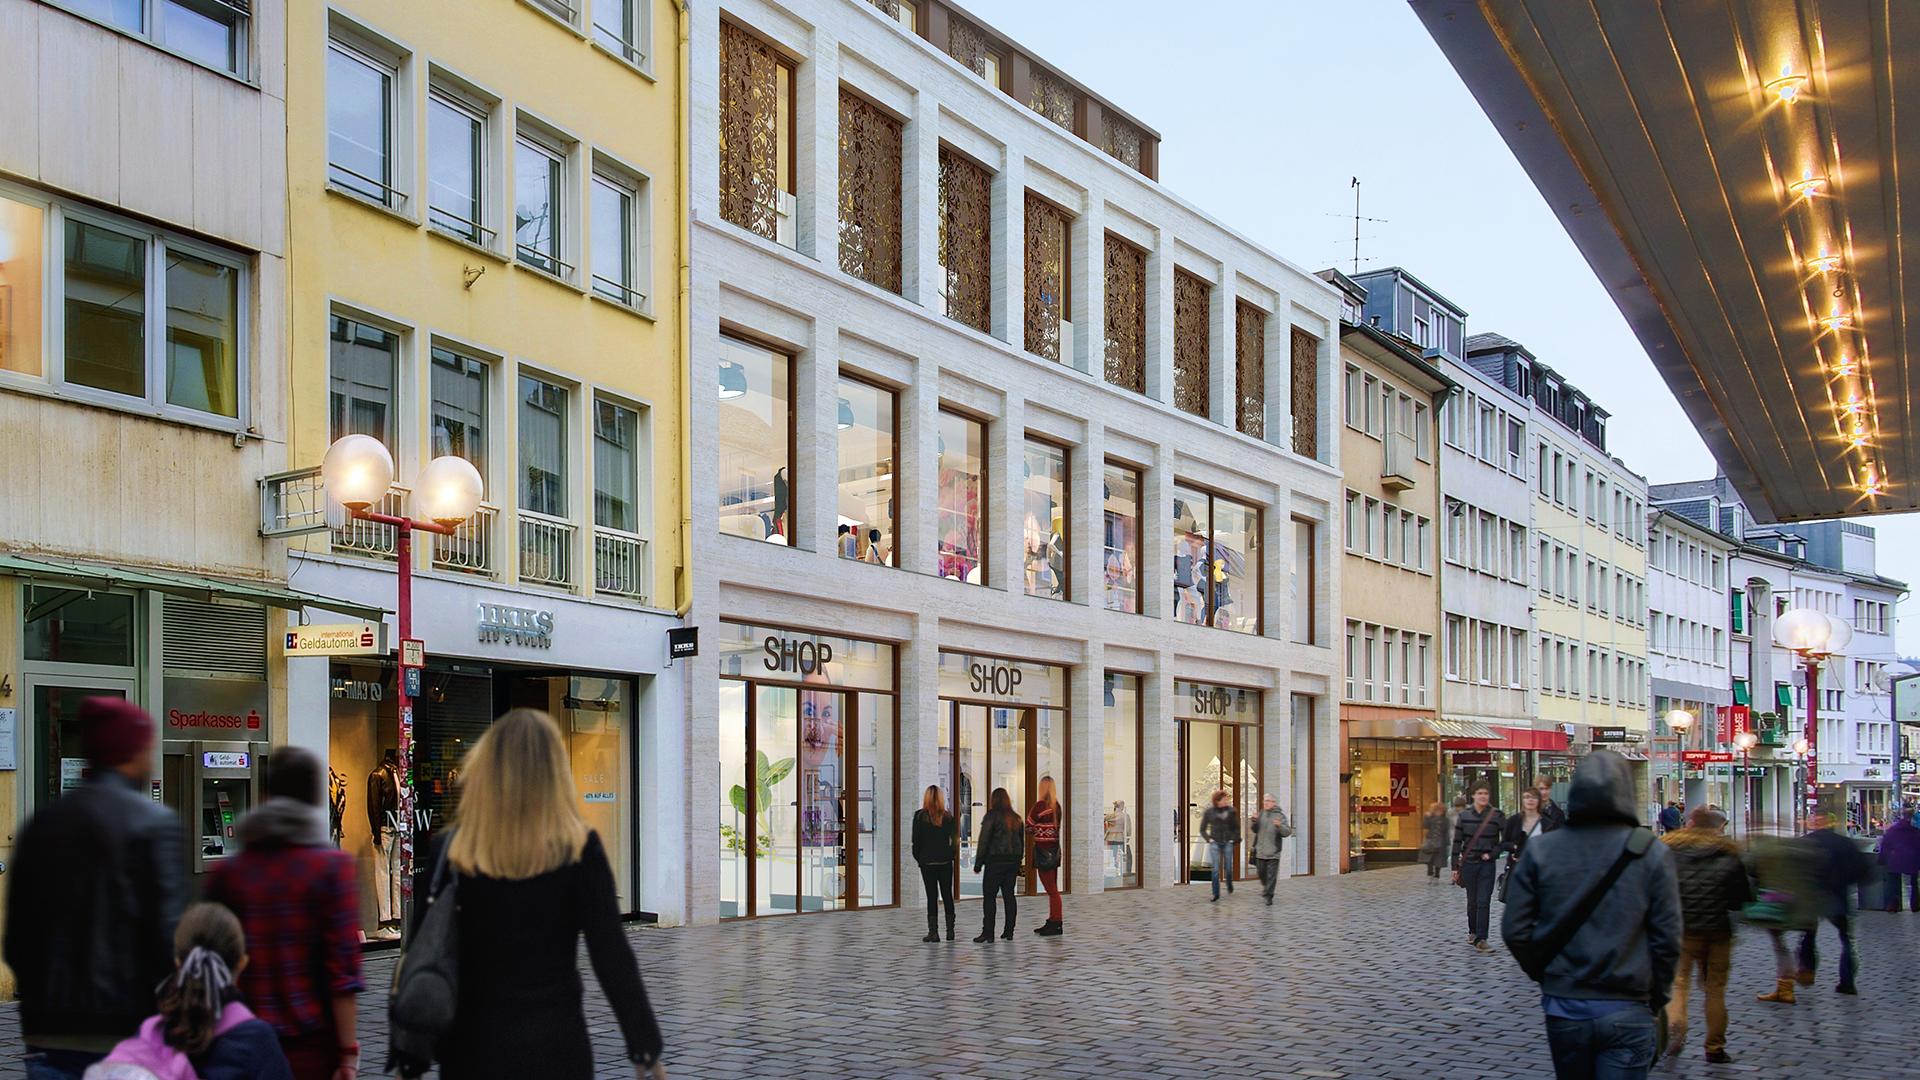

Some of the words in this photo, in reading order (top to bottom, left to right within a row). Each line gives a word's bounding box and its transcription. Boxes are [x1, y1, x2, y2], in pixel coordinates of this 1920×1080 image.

[299, 638, 358, 649] Geldautomat
[763, 636, 832, 675] SHOP
[970, 663, 1022, 696] SHOP
[1194, 689, 1231, 716] SHOP
[169, 709, 241, 729] Sparkasse
[385, 809, 433, 832] NW
